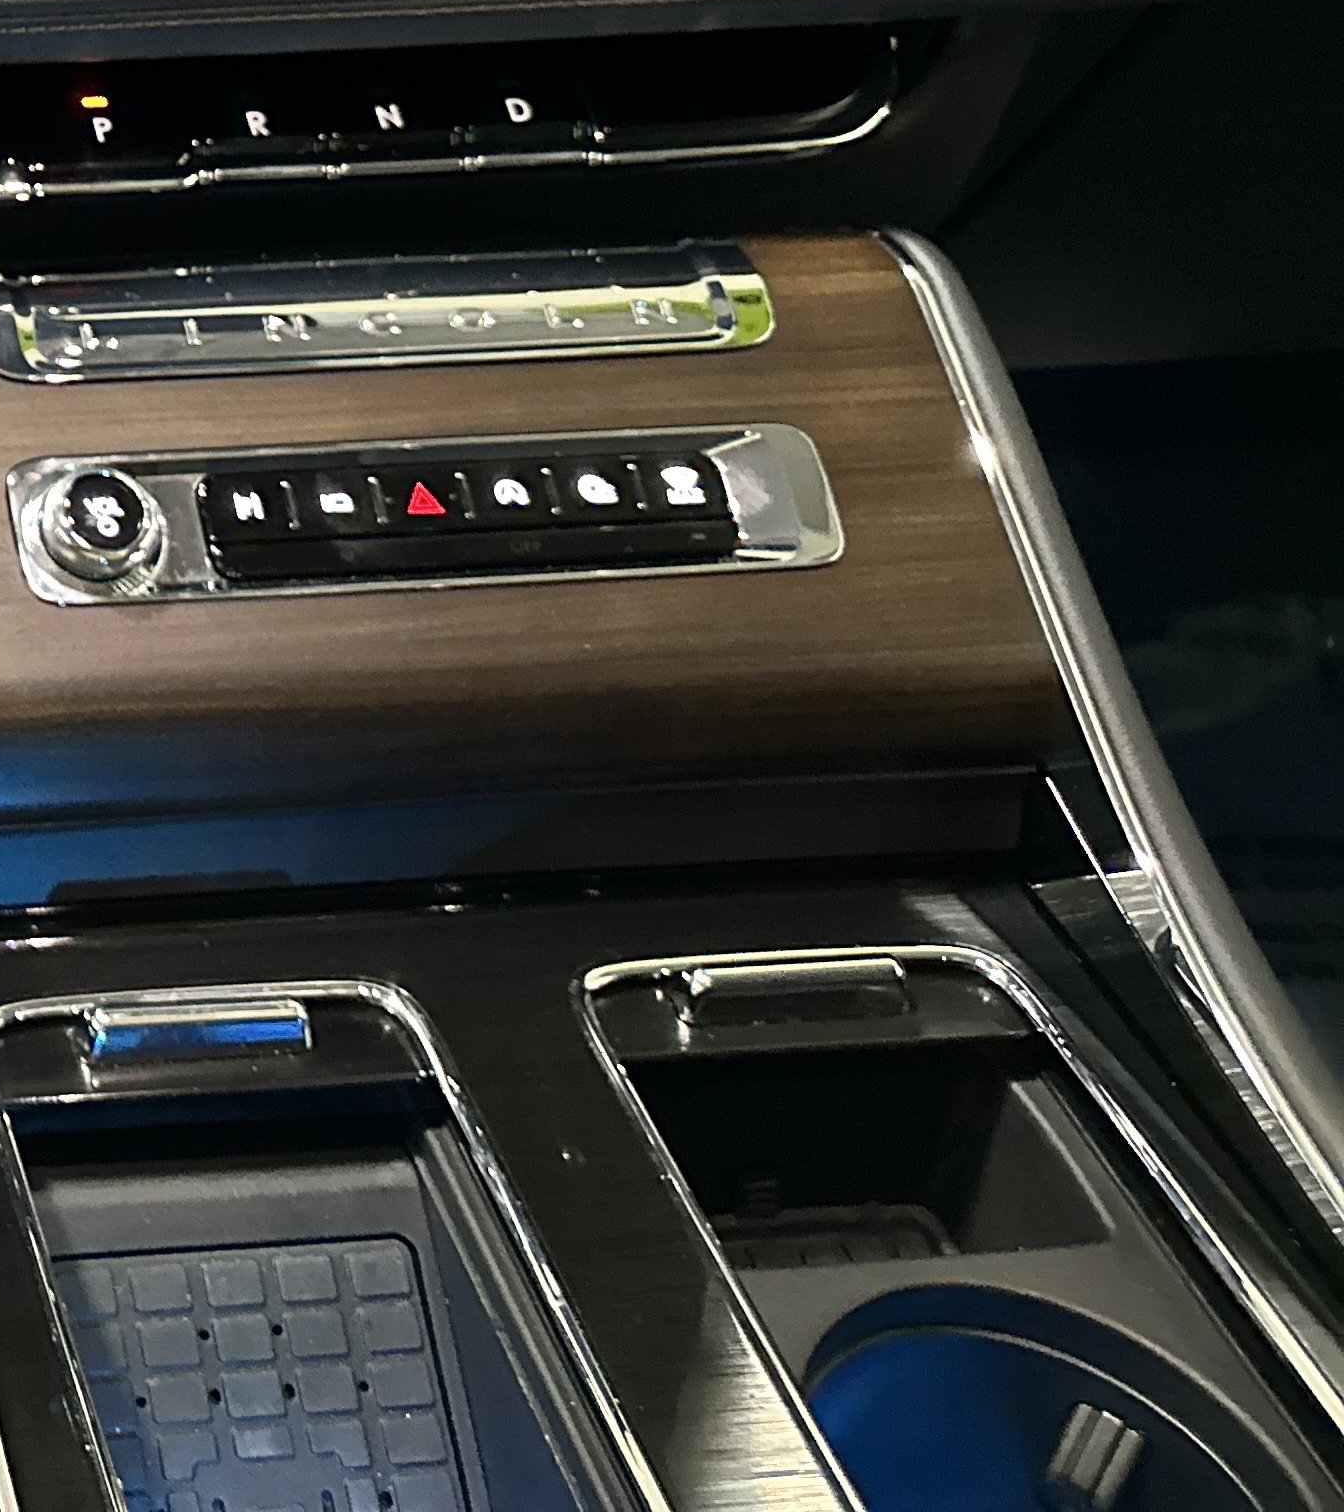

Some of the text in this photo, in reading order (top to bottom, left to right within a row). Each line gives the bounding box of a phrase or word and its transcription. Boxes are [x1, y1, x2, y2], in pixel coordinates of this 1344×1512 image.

[244, 109, 272, 137] R
[373, 103, 406, 130] N
[504, 97, 535, 124] D
[92, 116, 113, 144] P
[80, 296, 682, 350] LINCOLN
